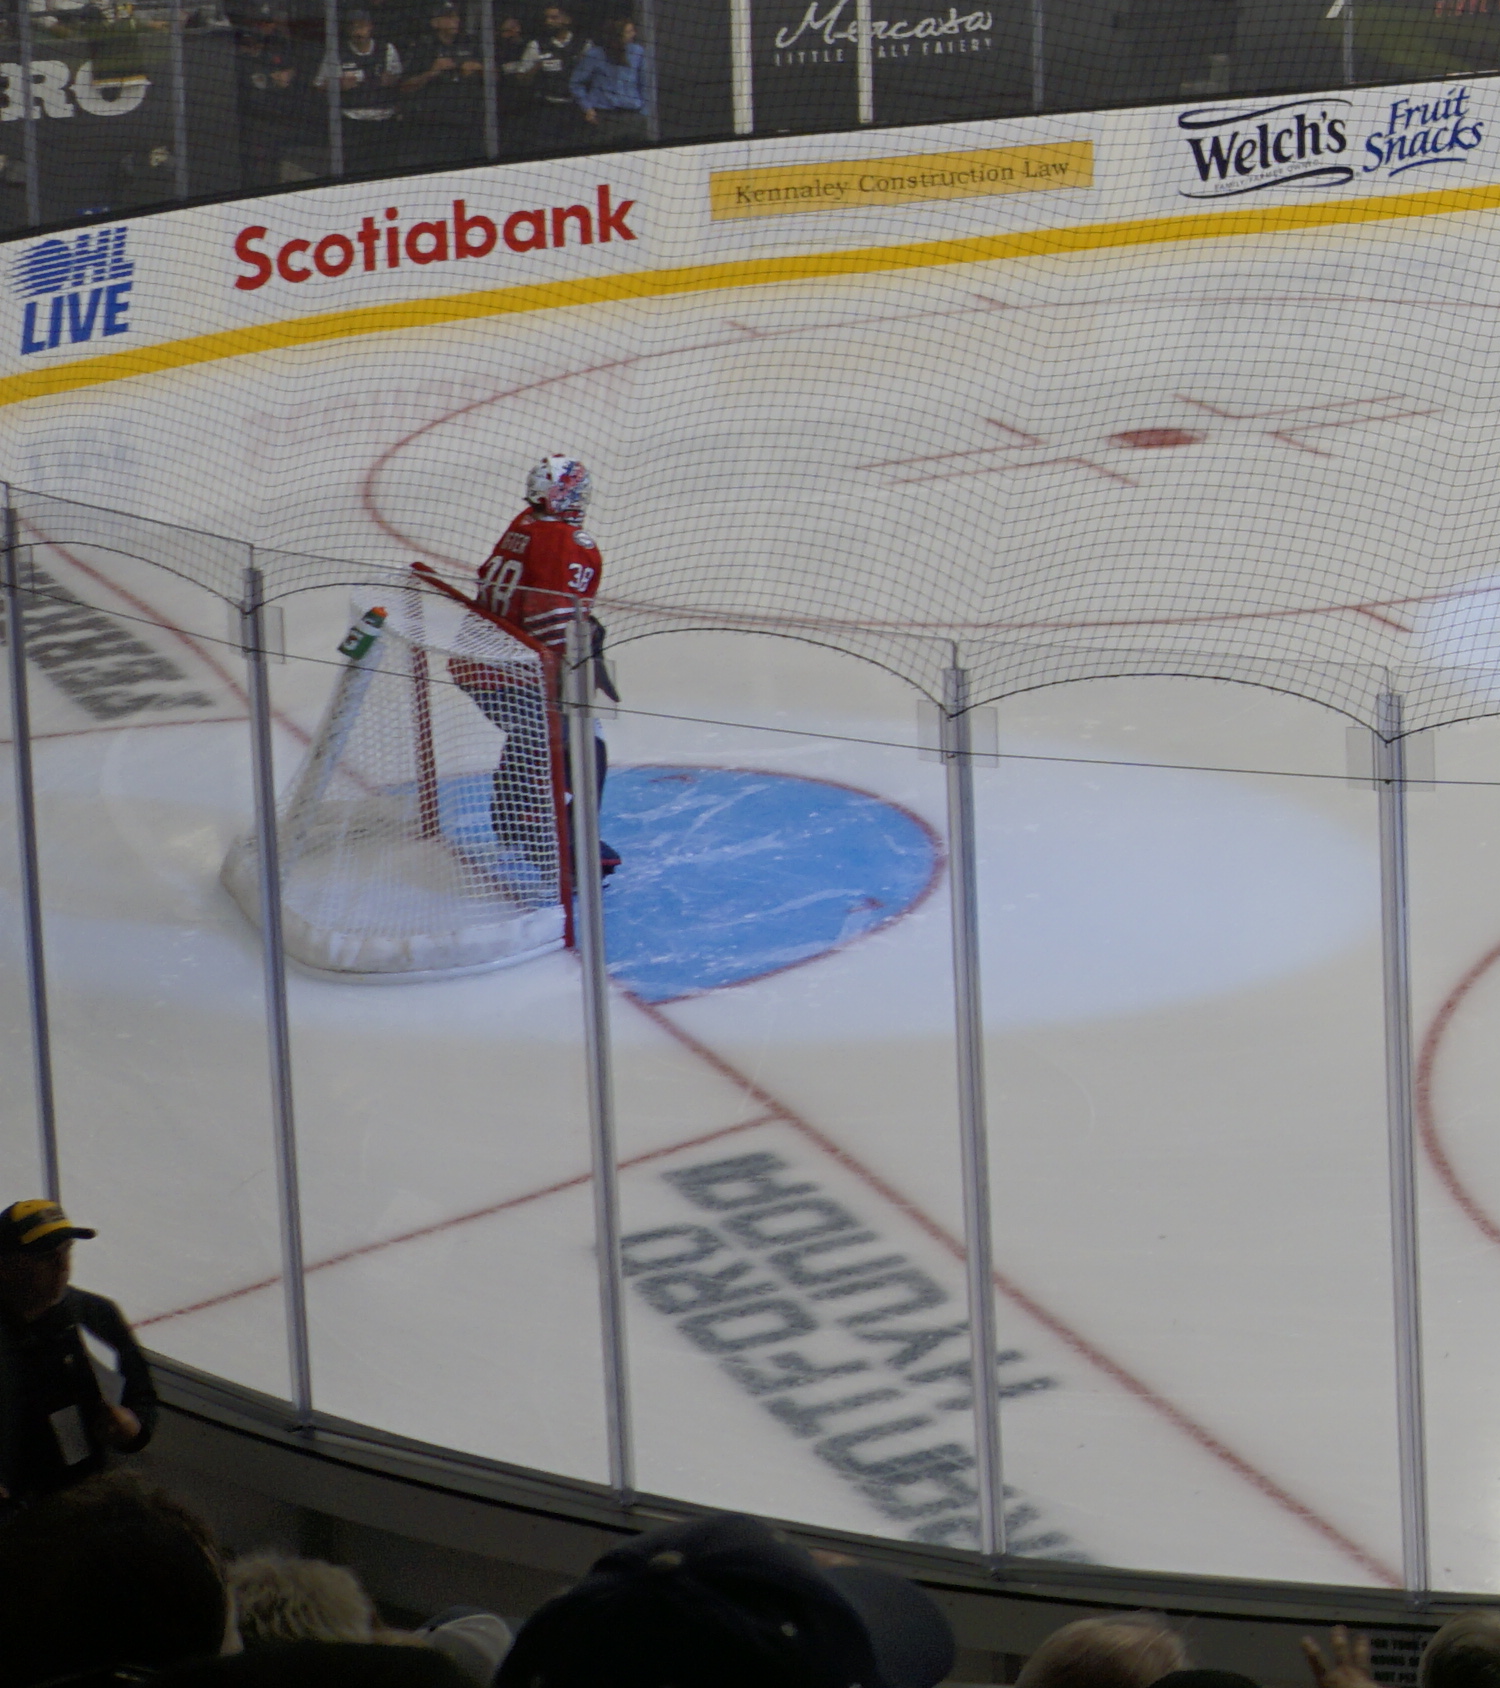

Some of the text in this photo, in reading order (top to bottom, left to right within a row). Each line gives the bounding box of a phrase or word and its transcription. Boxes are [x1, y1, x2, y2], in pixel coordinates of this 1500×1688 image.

[1185, 111, 1349, 183] Welch's
[1363, 116, 1485, 175] Snacks
[1389, 86, 1471, 137] Fruit
[734, 157, 1070, 206] Kennaley Construction Law
[8, 226, 136, 300] OHL
[233, 183, 639, 292] Scotiabank
[20, 281, 134, 356] LIVE
